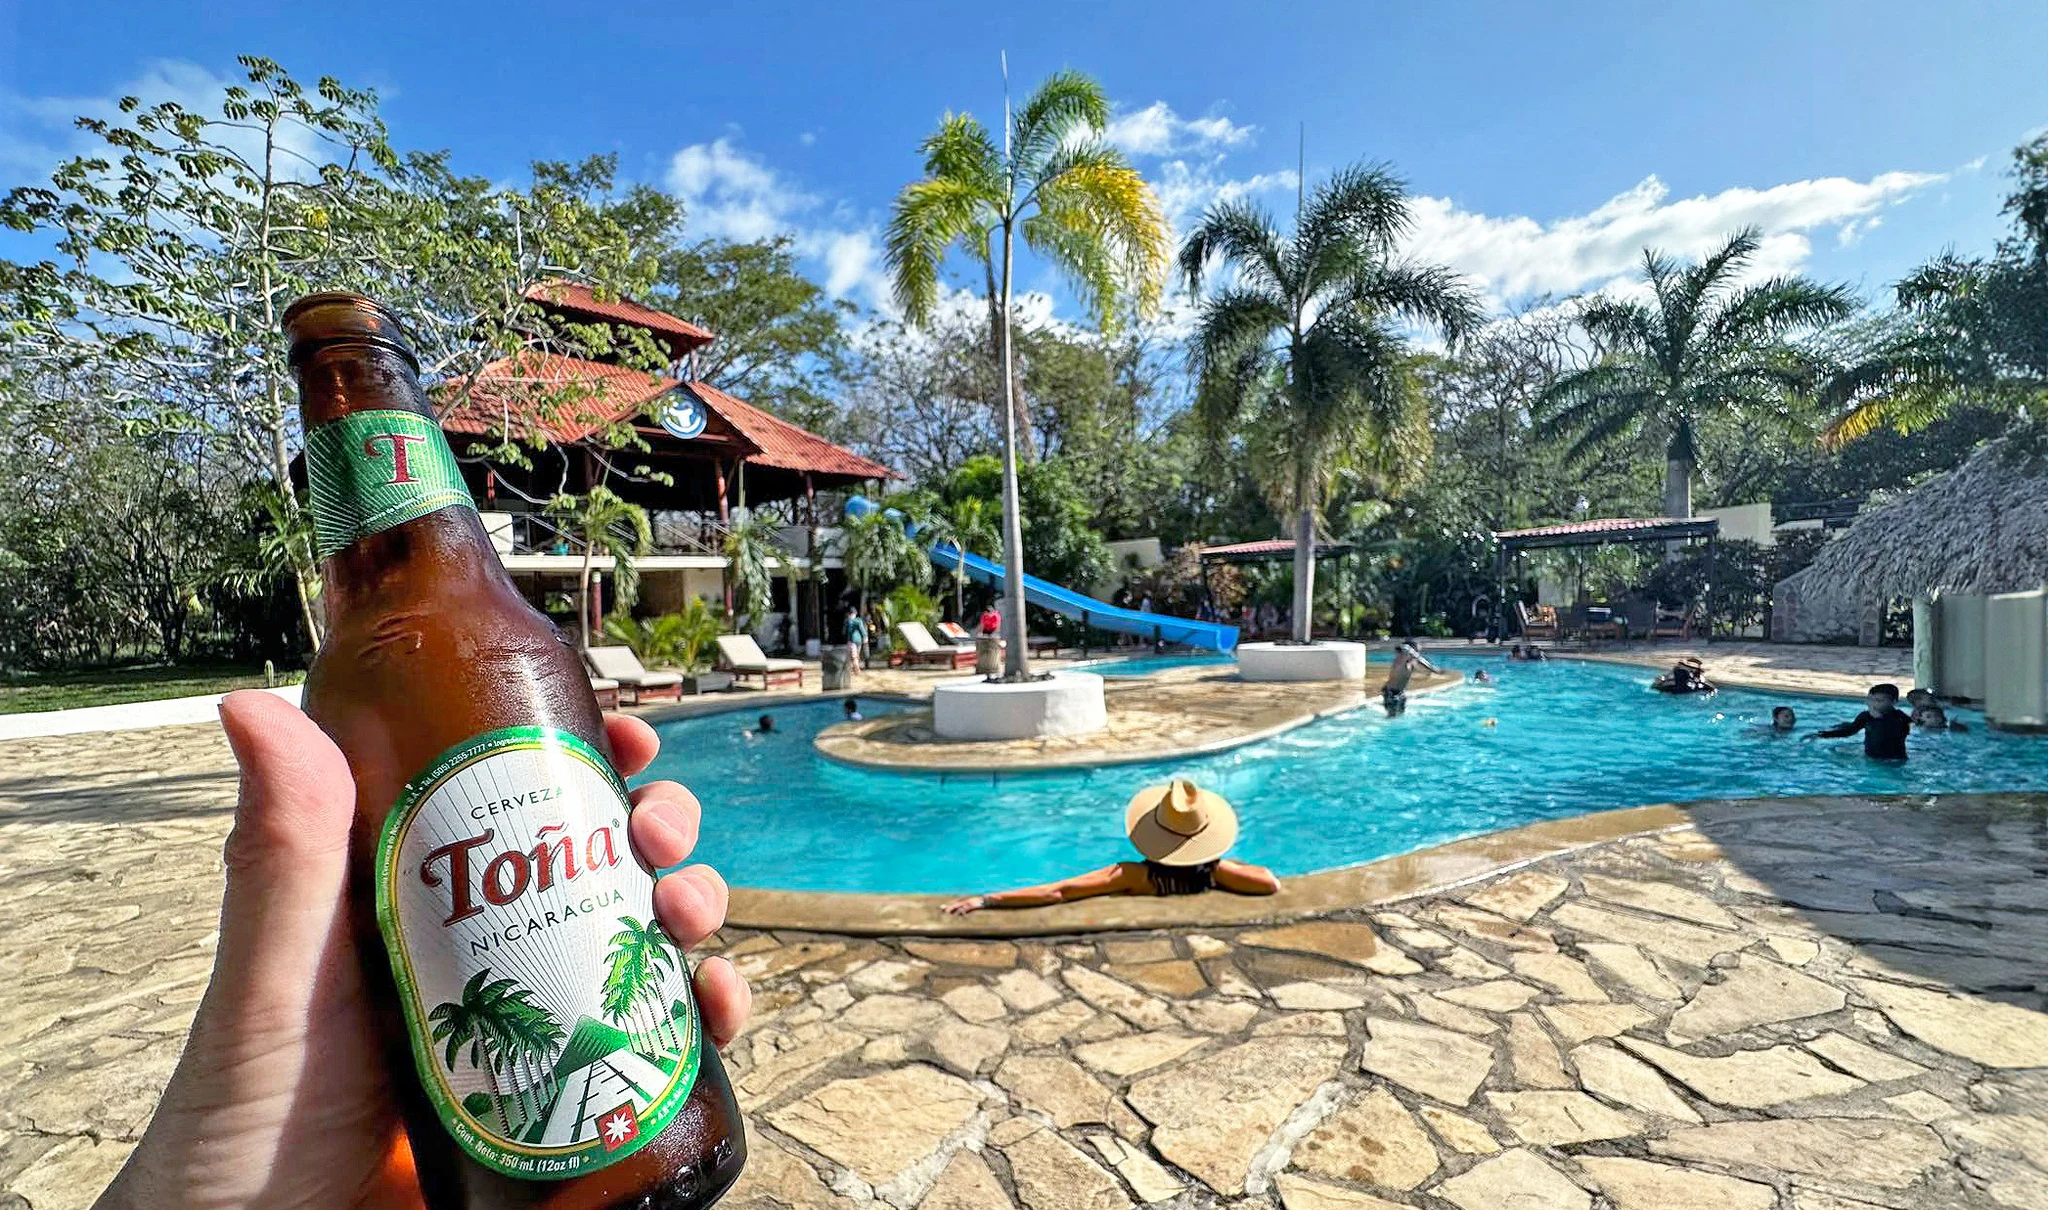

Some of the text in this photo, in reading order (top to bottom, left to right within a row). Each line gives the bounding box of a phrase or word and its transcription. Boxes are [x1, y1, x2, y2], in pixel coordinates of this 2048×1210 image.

[364, 433, 426, 485] T
[432, 763, 450, 779] (505)
[448, 743, 487, 766] 2255-7777
[420, 821, 623, 928] Toña
[470, 889, 625, 957] NICARAGUA
[499, 1152, 519, 1170] 350
[519, 1159, 535, 1171] mL
[537, 1159, 567, 1173] (12oz
[568, 1155, 580, 1170] fl)
